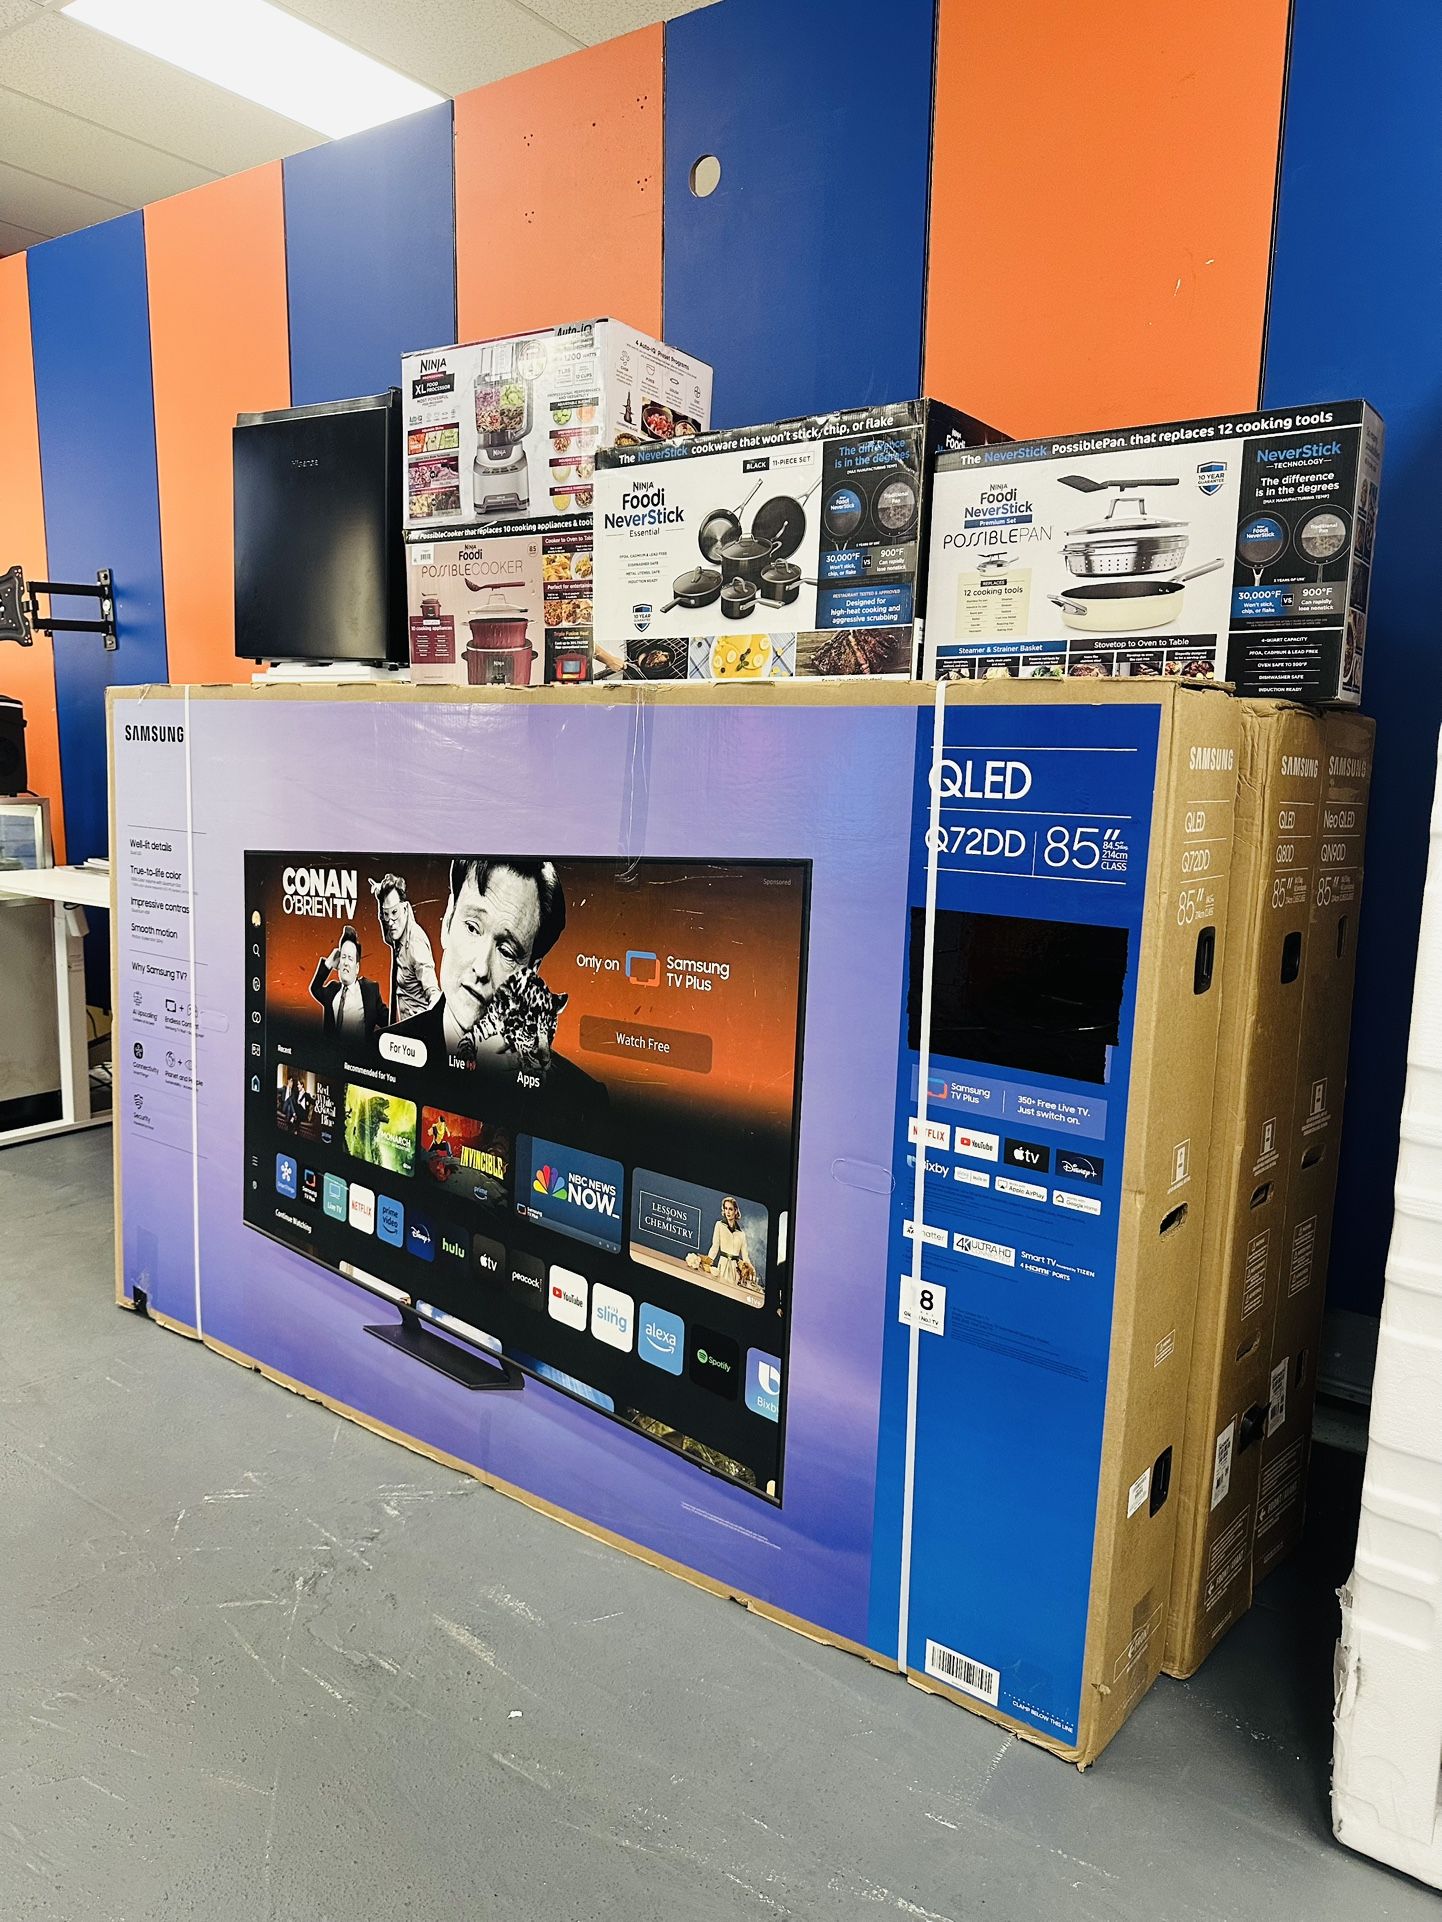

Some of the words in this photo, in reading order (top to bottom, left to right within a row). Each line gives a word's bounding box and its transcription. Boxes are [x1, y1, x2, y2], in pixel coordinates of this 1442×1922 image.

[420, 358, 447, 373] NINJA
[415, 384, 427, 396] XL
[619, 454, 635, 464] The
[638, 445, 688, 462] NeverStick
[692, 441, 738, 454] cookware
[740, 433, 760, 447] that
[762, 430, 791, 444] won't
[824, 422, 849, 436] chip,
[852, 421, 865, 431] or
[866, 416, 894, 430] flake
[961, 454, 981, 465] The
[984, 445, 1047, 463] NeverStick
[1130, 432, 1156, 446] that
[1159, 427, 1215, 443] replaces
[1218, 423, 1233, 436] 12
[1236, 416, 1292, 433] cooking
[1295, 411, 1333, 426] tools
[834, 459, 842, 468] is
[844, 458, 853, 467] in
[855, 455, 870, 466] the
[872, 451, 910, 464] degrees
[1257, 441, 1341, 462] NeverStick
[746, 461, 767, 470] BLACK
[772, 457, 797, 466] 11-PIECE
[1273, 458, 1324, 469] TECHNOLOGY
[1206, 472, 1225, 480] YEAR
[1260, 477, 1279, 486] The
[1282, 472, 1335, 484] difference
[632, 481, 654, 492] NINJA
[989, 483, 1008, 491] NINJA
[1255, 488, 1264, 497] is
[1266, 487, 1275, 496] in
[1278, 486, 1295, 494] the
[1297, 482, 1340, 494] degrees
[622, 488, 665, 510] Foodi
[980, 488, 1017, 504] Foodi
[604, 507, 684, 529] NeverStick
[964, 501, 1033, 519] NeverStick
[420, 530, 464, 540] PossibleCooker
[465, 528, 477, 536] that
[477, 525, 502, 535] replaces
[512, 523, 536, 532] cooking
[537, 520, 572, 531] appliances
[573, 519, 578, 527] &
[979, 517, 1005, 526] Premium
[630, 528, 660, 537] Essential
[943, 525, 1052, 549] POSSIBLEPAN
[459, 549, 483, 560] Foodi
[422, 560, 523, 578] POSSIBLECOOKER
[964, 589, 972, 597] 12
[973, 588, 1003, 597] cooking
[1004, 586, 1023, 594] tools
[830, 607, 860, 616] high-heat
[861, 605, 887, 614] cooking
[846, 598, 876, 607] Designed
[958, 647, 985, 655] Steamer
[993, 645, 1018, 653] Strainer
[1020, 644, 1043, 652] Basket
[1094, 640, 1126, 649] Stovetop
[1128, 639, 1136, 647] to
[1137, 639, 1157, 647] Oven
[1168, 638, 1190, 646] Table
[125, 724, 184, 742] SAMSUNG
[1189, 747, 1234, 770] SAMSUNG
[1281, 755, 1319, 778] SAMSUNG
[1328, 755, 1367, 778] SAMSUNG
[928, 759, 1032, 800] QLED
[1185, 811, 1206, 833] QLED
[1278, 810, 1296, 830] QLED
[1323, 809, 1339, 828] Neo
[1339, 810, 1355, 829] QLED
[924, 826, 1026, 857] Q72DD
[1181, 849, 1211, 873] Q72DD
[1276, 845, 1295, 863] Q80D
[130, 865, 165, 878] True-to-life
[165, 870, 182, 880] color
[1100, 861, 1127, 871] CLASS
[282, 867, 358, 899] CONAN
[763, 877, 792, 886] Sponsored
[130, 896, 164, 910] Impressive
[165, 903, 190, 914] contras
[131, 922, 155, 935] Smooth
[156, 928, 178, 939] motion
[131, 961, 146, 975] Why
[146, 964, 175, 981] Samsung
[176, 970, 188, 981] TV?
[576, 953, 601, 973] Only
[604, 958, 620, 971] on
[666, 955, 730, 979] Samsung
[666, 972, 681, 988] TV
[685, 975, 712, 991] Plus
[389, 1041, 401, 1053] For
[402, 1043, 416, 1058] You
[616, 1031, 646, 1050] Watch
[647, 1039, 670, 1053] Free
[449, 1054, 466, 1070] Live
[516, 1070, 540, 1088] Apps
[951, 1082, 991, 1099] Samsung
[951, 1091, 962, 1100] TV
[963, 1094, 980, 1104] Plus
[1017, 1095, 1036, 1105] 350+
[1037, 1099, 1057, 1109] Free
[1058, 1103, 1076, 1113] Live
[1077, 1107, 1091, 1117] TV.
[1017, 1105, 1035, 1116] Just
[1036, 1109, 1066, 1122] switch
[1067, 1117, 1081, 1125] on.
[972, 1140, 994, 1152] YouTube
[460, 1145, 504, 1180] INVINCIBLE
[568, 1172, 588, 1187] NBC
[588, 1176, 617, 1196] NEWS
[351, 1200, 372, 1217] NETFLIX
[382, 1206, 399, 1218] prime
[651, 1202, 688, 1221] LESSONS
[382, 1215, 399, 1229] video
[644, 1216, 693, 1240] CHEMISTRY
[442, 1237, 465, 1259] hulu
[956, 1237, 971, 1252] 4K
[971, 1239, 998, 1256] ULTRA
[999, 1247, 1012, 1258] HD
[562, 1291, 584, 1308] YouTube
[596, 1304, 627, 1333] sling
[645, 1322, 677, 1347] alexa
[708, 1356, 732, 1373] Spotify
[1012, 1700, 1031, 1712] CLAMP
[1031, 1709, 1050, 1722] BELOW
[1050, 1717, 1062, 1728] THIS
[1061, 1724, 1074, 1734] LINE
